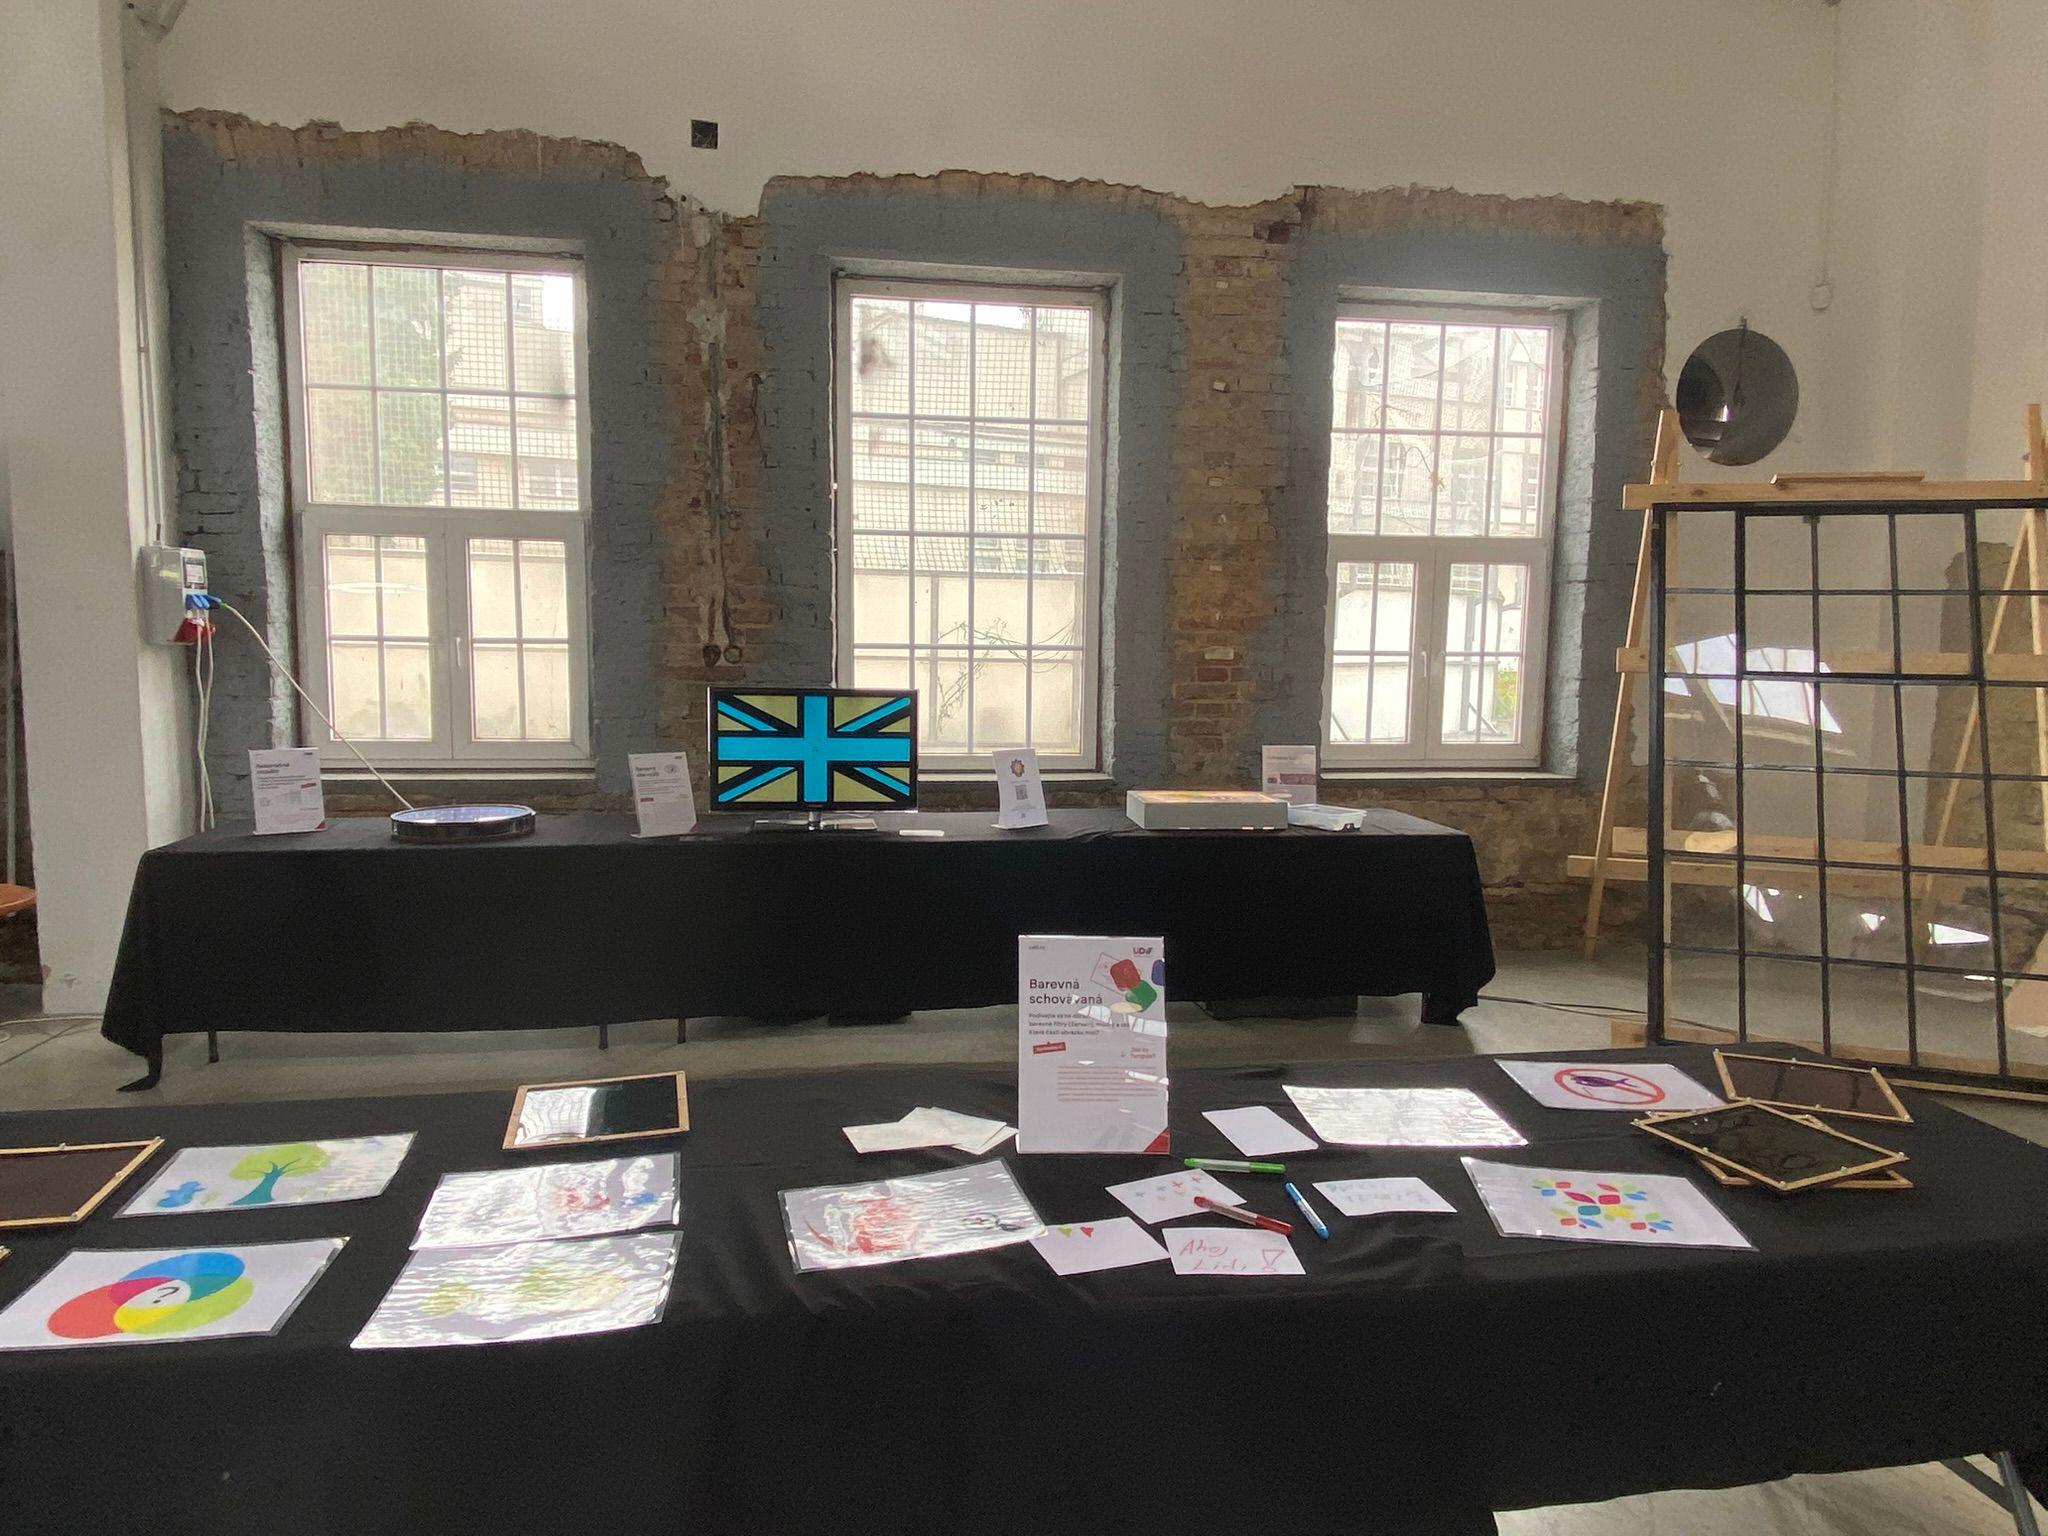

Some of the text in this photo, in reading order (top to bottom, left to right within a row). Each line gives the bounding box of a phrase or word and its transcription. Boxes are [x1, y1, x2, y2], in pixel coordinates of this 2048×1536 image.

[1029, 978, 1080, 990] Barevná
[1029, 994, 1103, 1005] schovávaná
[1179, 1239, 1229, 1258] Ahoj
